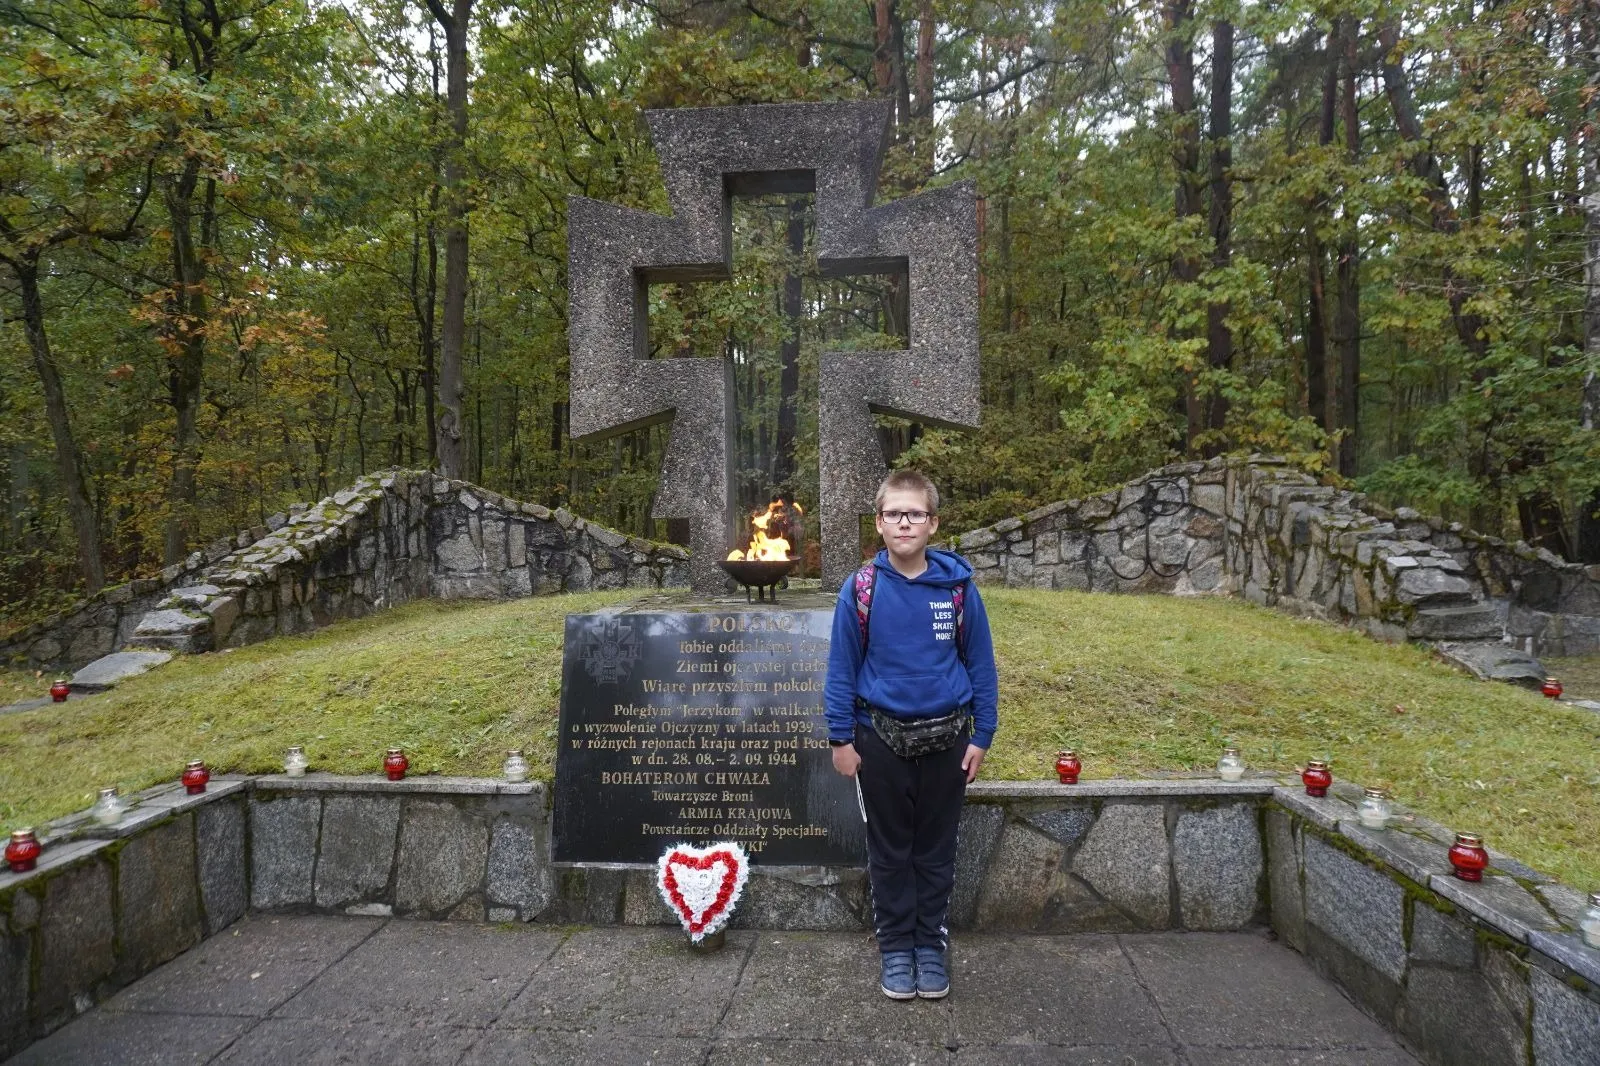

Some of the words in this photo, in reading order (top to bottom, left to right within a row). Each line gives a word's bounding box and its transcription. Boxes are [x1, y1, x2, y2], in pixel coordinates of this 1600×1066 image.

[928, 601, 953, 610] THINK
[934, 611, 952, 620] LESS
[932, 622, 954, 630] SKATE
[935, 632, 952, 641] MORE
[676, 659, 718, 673] Ziemi
[641, 679, 686, 694] Wiarę
[614, 703, 672, 719] Poległym
[752, 706, 766, 716] w
[769, 703, 825, 716] walkach
[572, 724, 580, 733] o
[584, 720, 657, 736] wyzwolenie
[661, 721, 720, 736] Ojczyzny
[725, 724, 737, 733] w
[742, 720, 780, 733] latach
[785, 720, 814, 733] 1939
[571, 739, 583, 749] w
[587, 736, 637, 752] różnych
[641, 736, 696, 751] rejonach
[701, 736, 736, 751] kraju
[740, 739, 769, 749] oraz
[774, 736, 798, 751] pod
[803, 736, 833, 749] Poci
[631, 755, 643, 765] w
[647, 752, 668, 766] dn.
[672, 753, 691, 766] 28.
[745, 753, 763, 766] 09.
[767, 753, 797, 766] 1944
[601, 772, 698, 785] BOHATEROM
[704, 772, 771, 785] CHWAŁA
[652, 790, 718, 803] Towarzysze
[722, 790, 754, 803] Broni
[677, 807, 723, 820] ARMIA
[727, 807, 792, 821] KRAJOWA
[641, 822, 710, 836] Powstańcze
[713, 823, 768, 839] Oddziały
[772, 824, 828, 838] Specjalne
